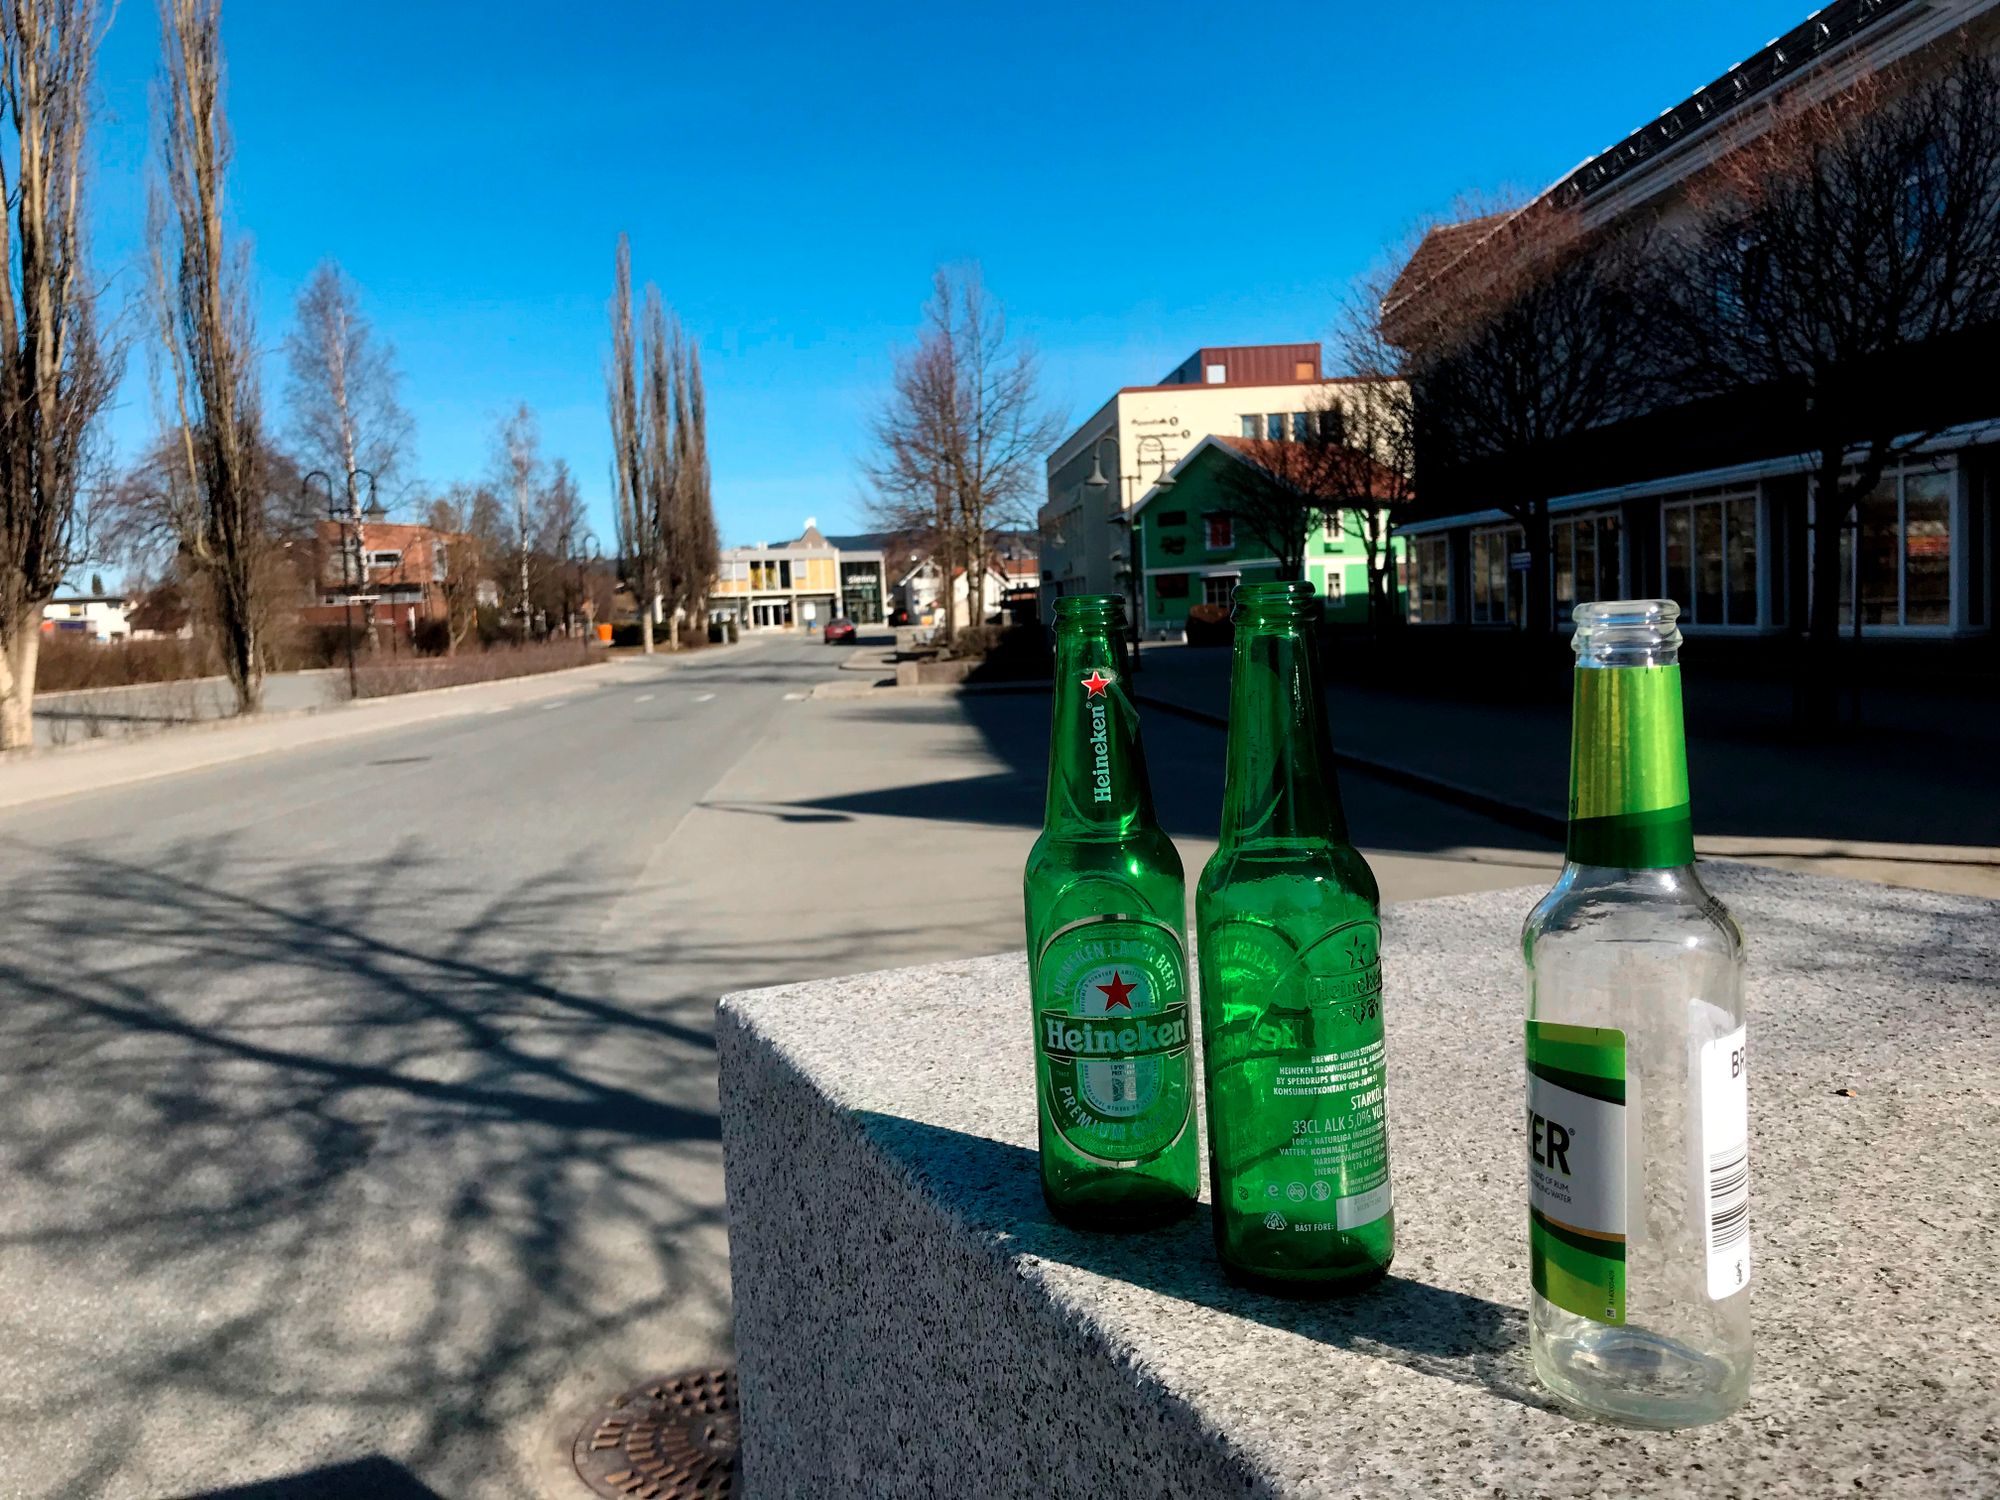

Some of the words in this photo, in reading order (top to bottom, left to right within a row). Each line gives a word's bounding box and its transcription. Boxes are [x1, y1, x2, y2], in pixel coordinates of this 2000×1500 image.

[1089, 704, 1112, 803] Heineken
[1155, 953, 1177, 991] BEER
[1045, 1017, 1187, 1054] Heineken
[1311, 1053, 1339, 1064] BREWED
[1340, 1049, 1360, 1060] UNDER
[1276, 1077, 1285, 1085] BY
[1287, 1075, 1329, 1085] SPENDRUPS
[1330, 1070, 1360, 1083] BRYGGERI
[1279, 1066, 1314, 1075] HEINEKEN
[1273, 1084, 1347, 1096] KONSUMENTKONTAKT
[1059, 1086, 1127, 1141] PREMIUM
[1292, 1119, 1321, 1134] 33CL
[1324, 1115, 1346, 1133] ALK
[1347, 1109, 1371, 1130] 5,0%
[1371, 1102, 1385, 1120] VOL
[1292, 1137, 1312, 1146] 100%
[1314, 1133, 1351, 1145] NATURLIGA
[1529, 1108, 1571, 1176] ER
[1279, 1148, 1309, 1157] VATTEN,
[1295, 1222, 1312, 1232] BÄST
[1314, 1221, 1335, 1232] FÖRE:
